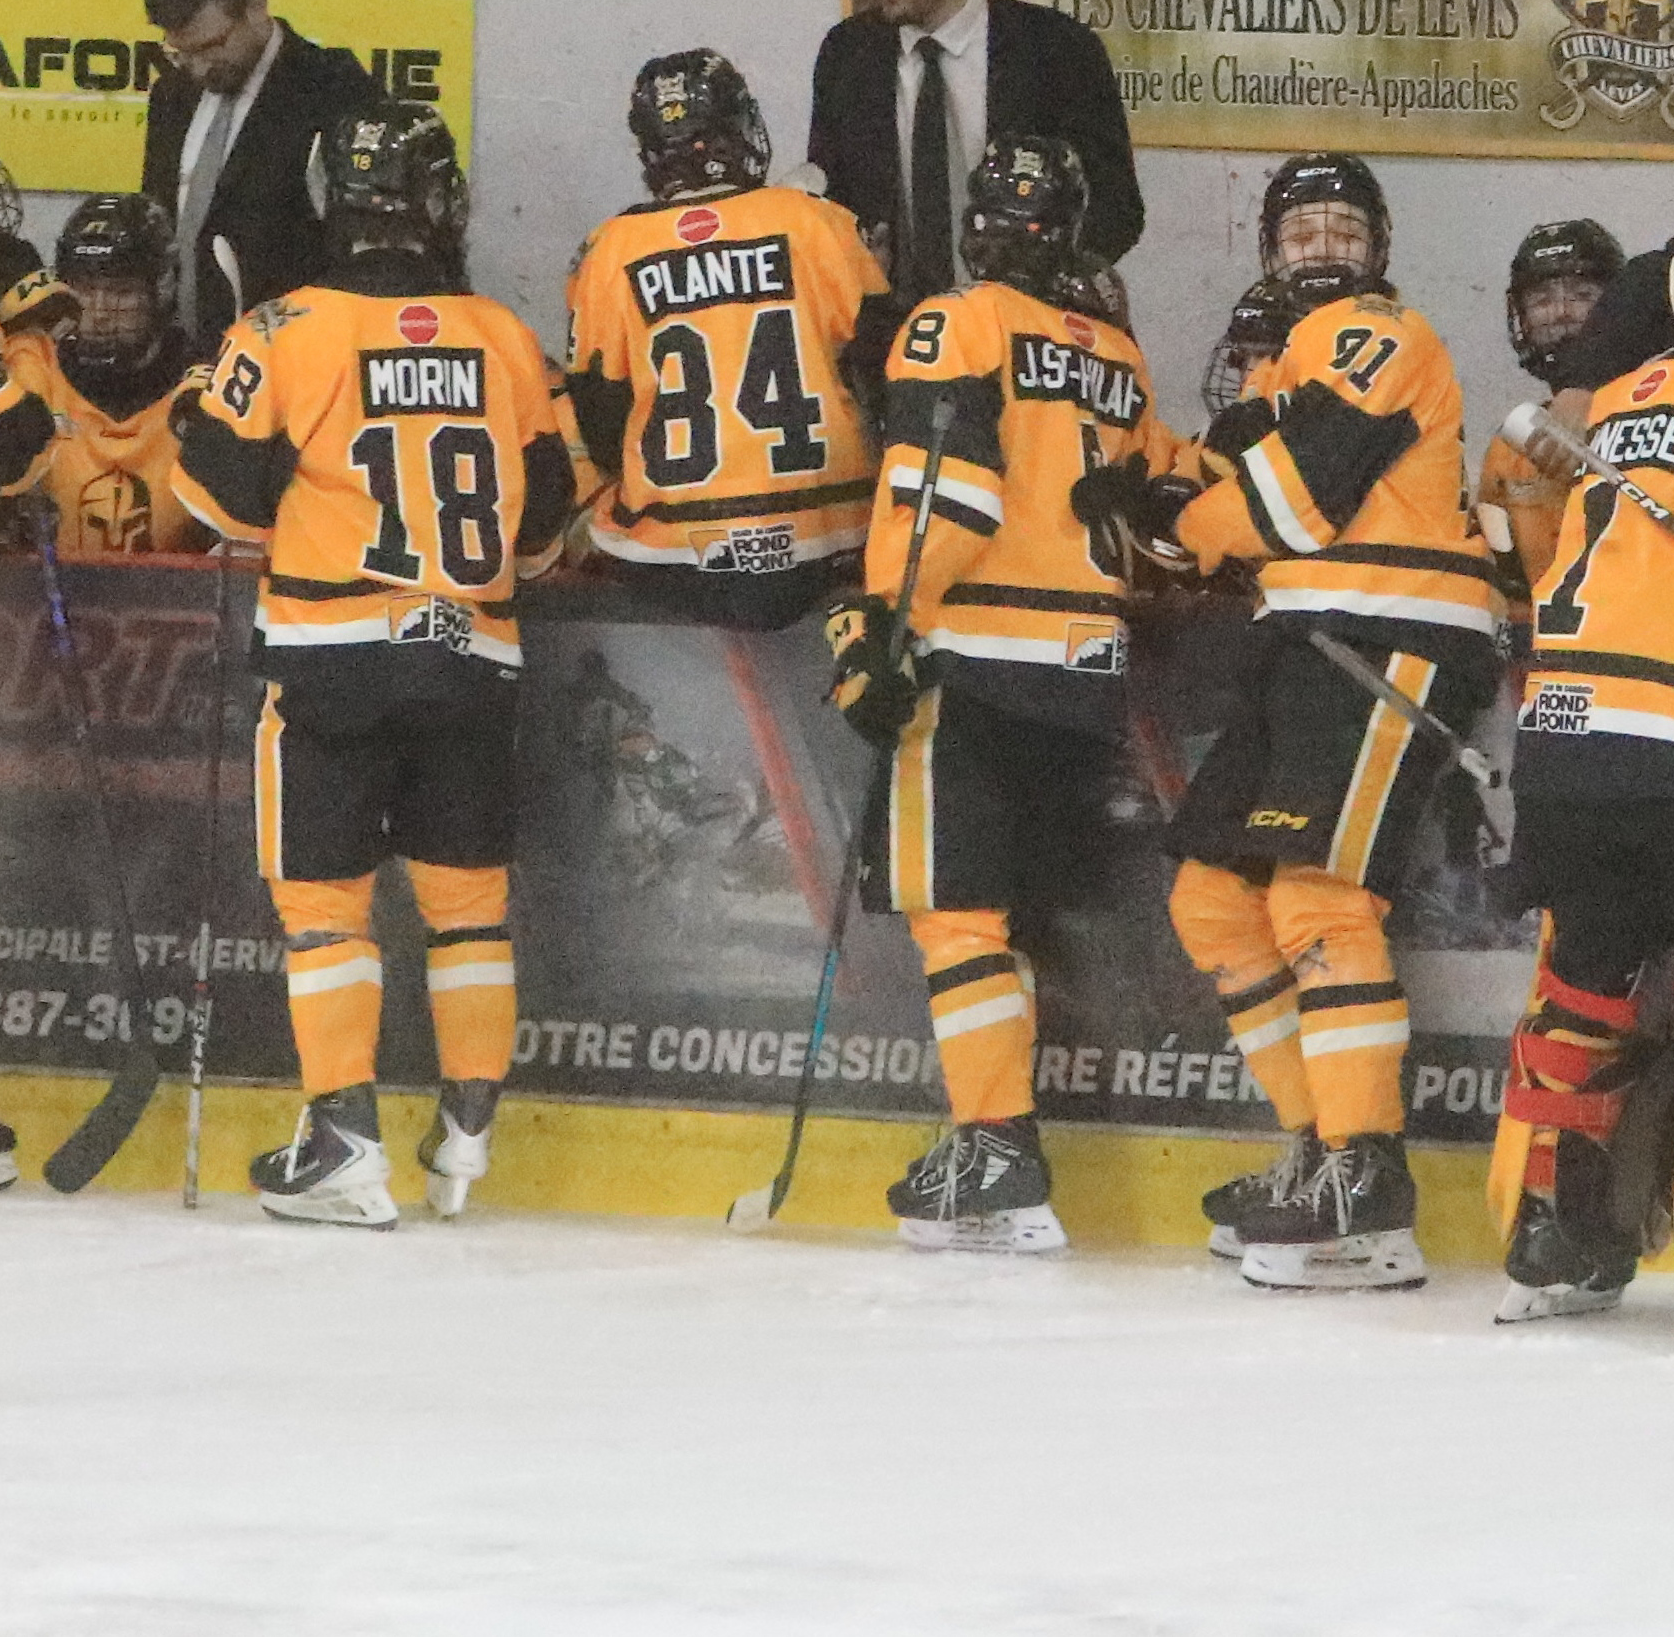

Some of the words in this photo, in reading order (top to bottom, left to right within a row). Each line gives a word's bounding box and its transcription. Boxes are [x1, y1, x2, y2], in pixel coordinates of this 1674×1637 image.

[1170, 53, 1204, 104] de
[1211, 53, 1519, 119] Chaudière-Appalaches
[350, 153, 373, 171] 18
[1295, 166, 1338, 179] CCM
[74, 245, 114, 255] CCM
[636, 243, 786, 316] PLANTE
[1533, 244, 1575, 258] CCM
[902, 309, 948, 365] 8
[1327, 326, 1401, 397] 91
[367, 358, 478, 409] MORIN
[640, 307, 829, 490] 84
[347, 422, 508, 590] 18
[1535, 477, 1622, 640] 1
[1538, 712, 1590, 733] POINT
[512, 1019, 636, 1069] OTRE
[1412, 1064, 1510, 1115] POU
